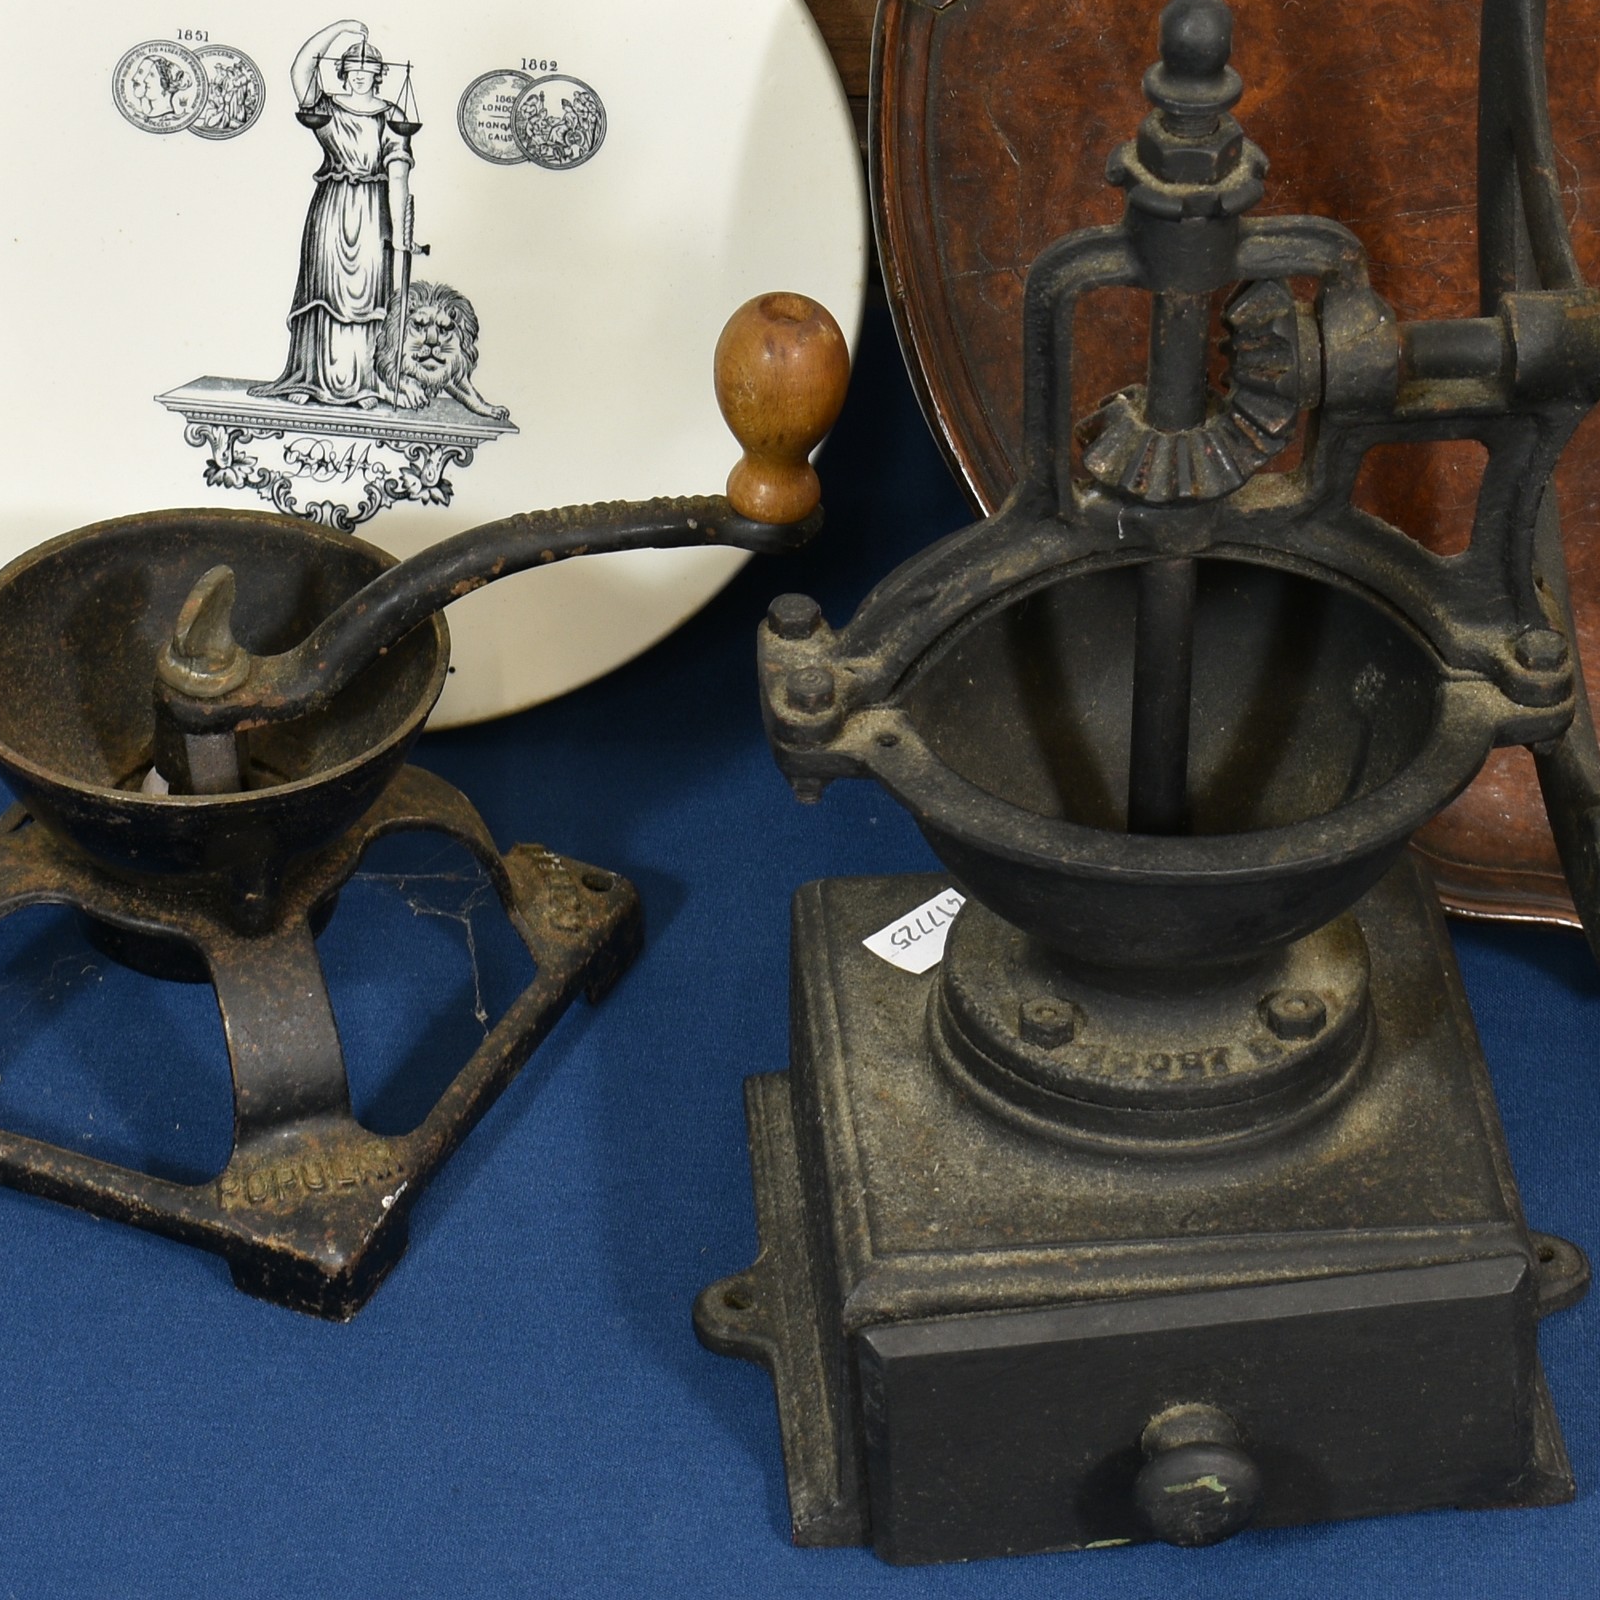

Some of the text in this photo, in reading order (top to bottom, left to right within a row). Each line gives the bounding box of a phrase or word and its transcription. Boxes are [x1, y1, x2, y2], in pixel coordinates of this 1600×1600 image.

[176, 28, 210, 43] 1851
[520, 57, 559, 73] 1862
[890, 897, 962, 950] 417725
